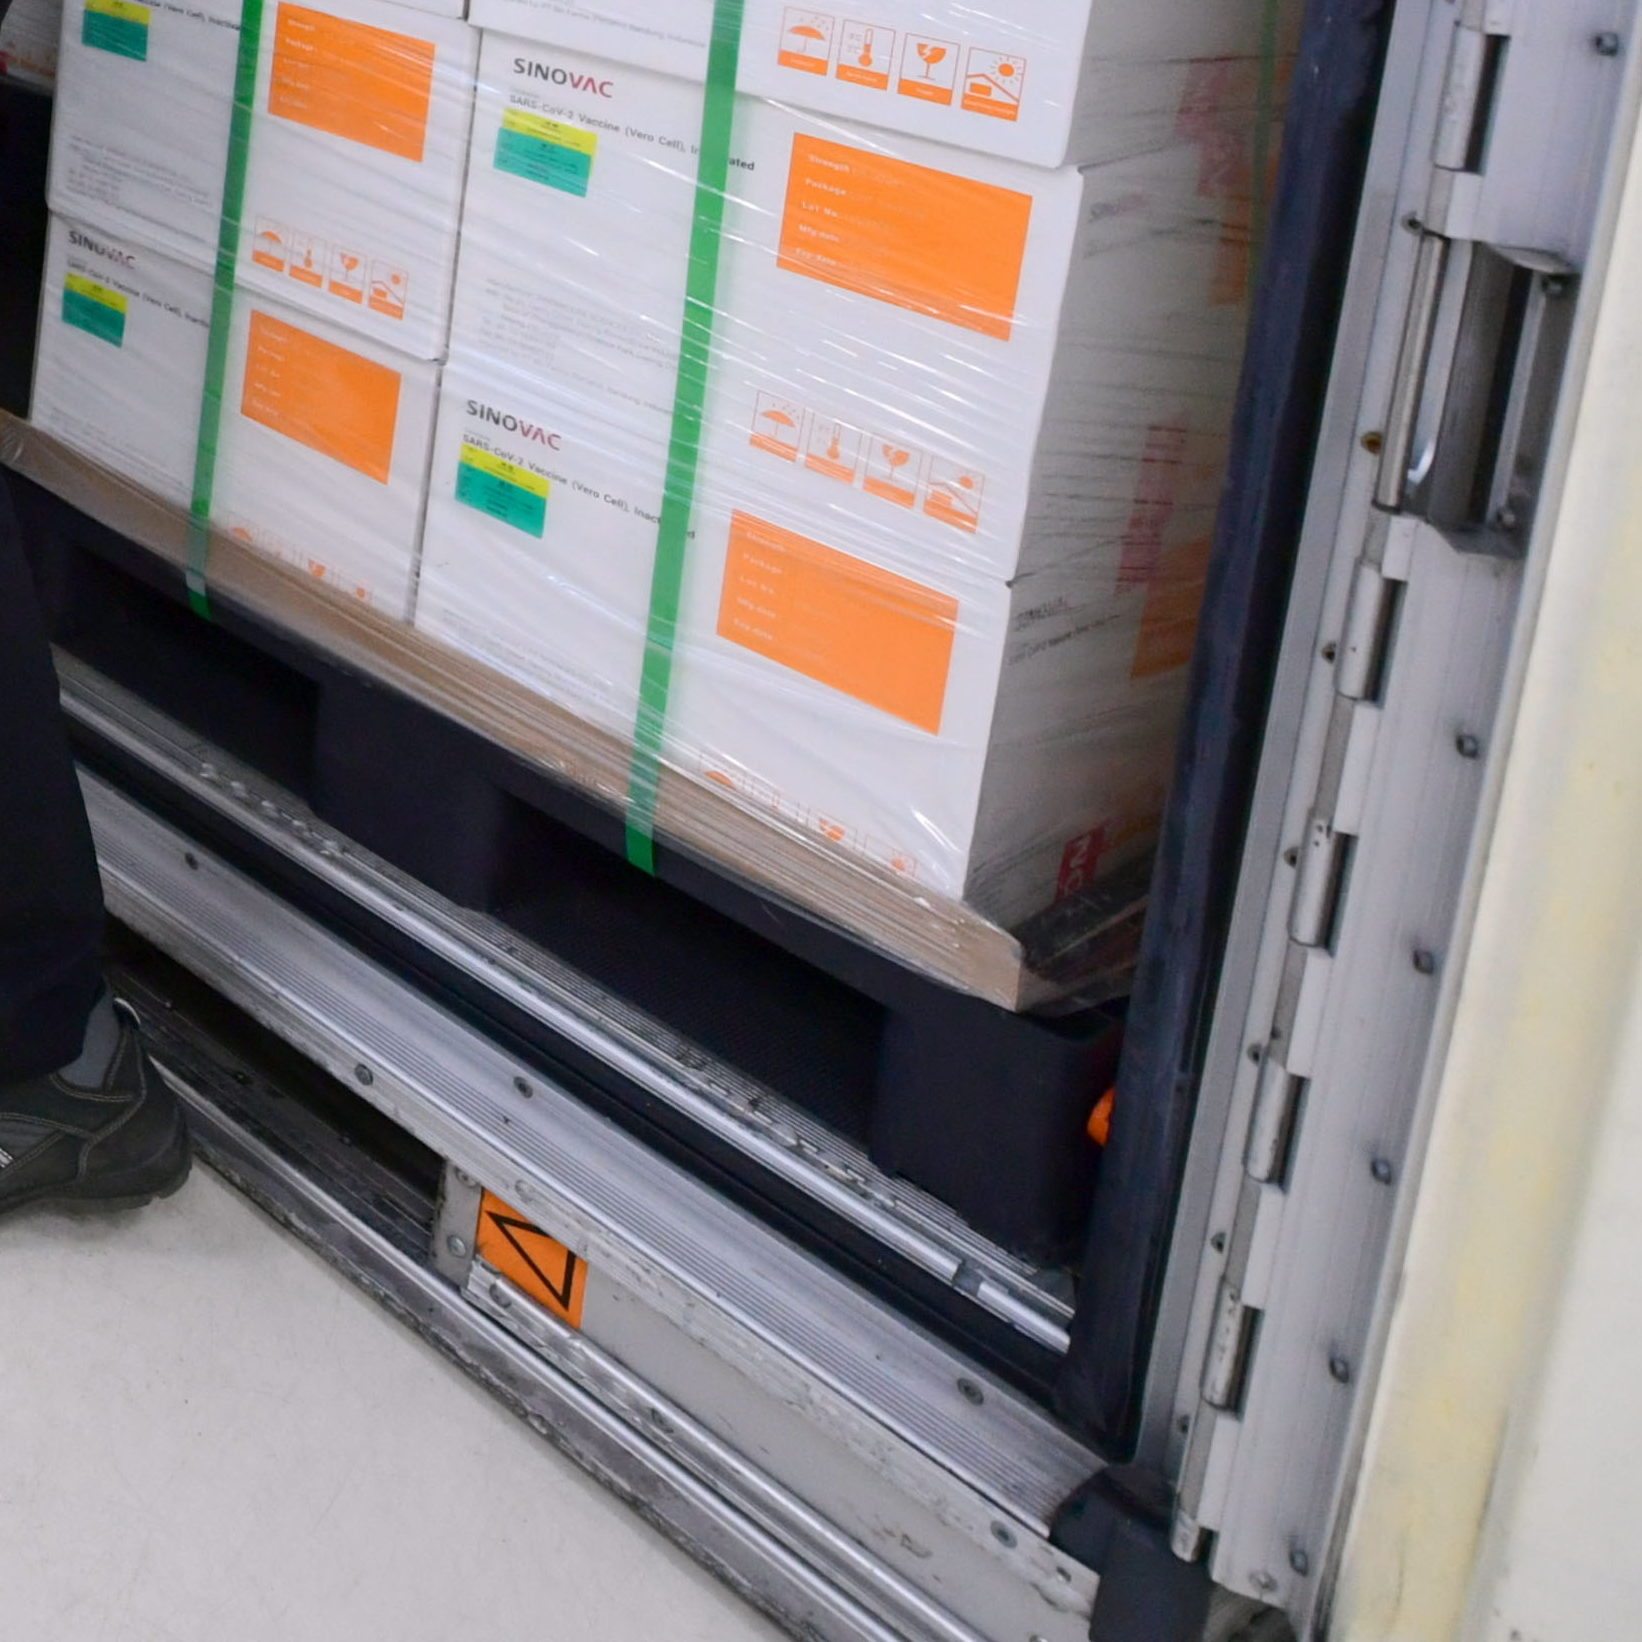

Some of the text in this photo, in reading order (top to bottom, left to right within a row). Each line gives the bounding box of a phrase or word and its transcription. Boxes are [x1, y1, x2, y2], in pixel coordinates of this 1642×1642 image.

[513, 57, 614, 99] SINOVAC
[509, 94, 574, 120] SARS-CoV-2
[579, 112, 621, 132] Vaccine
[625, 125, 655, 143] (Vero
[467, 399, 562, 451] SINOVAC
[528, 459, 568, 486] Vaccine
[571, 479, 600, 500] (Vero
